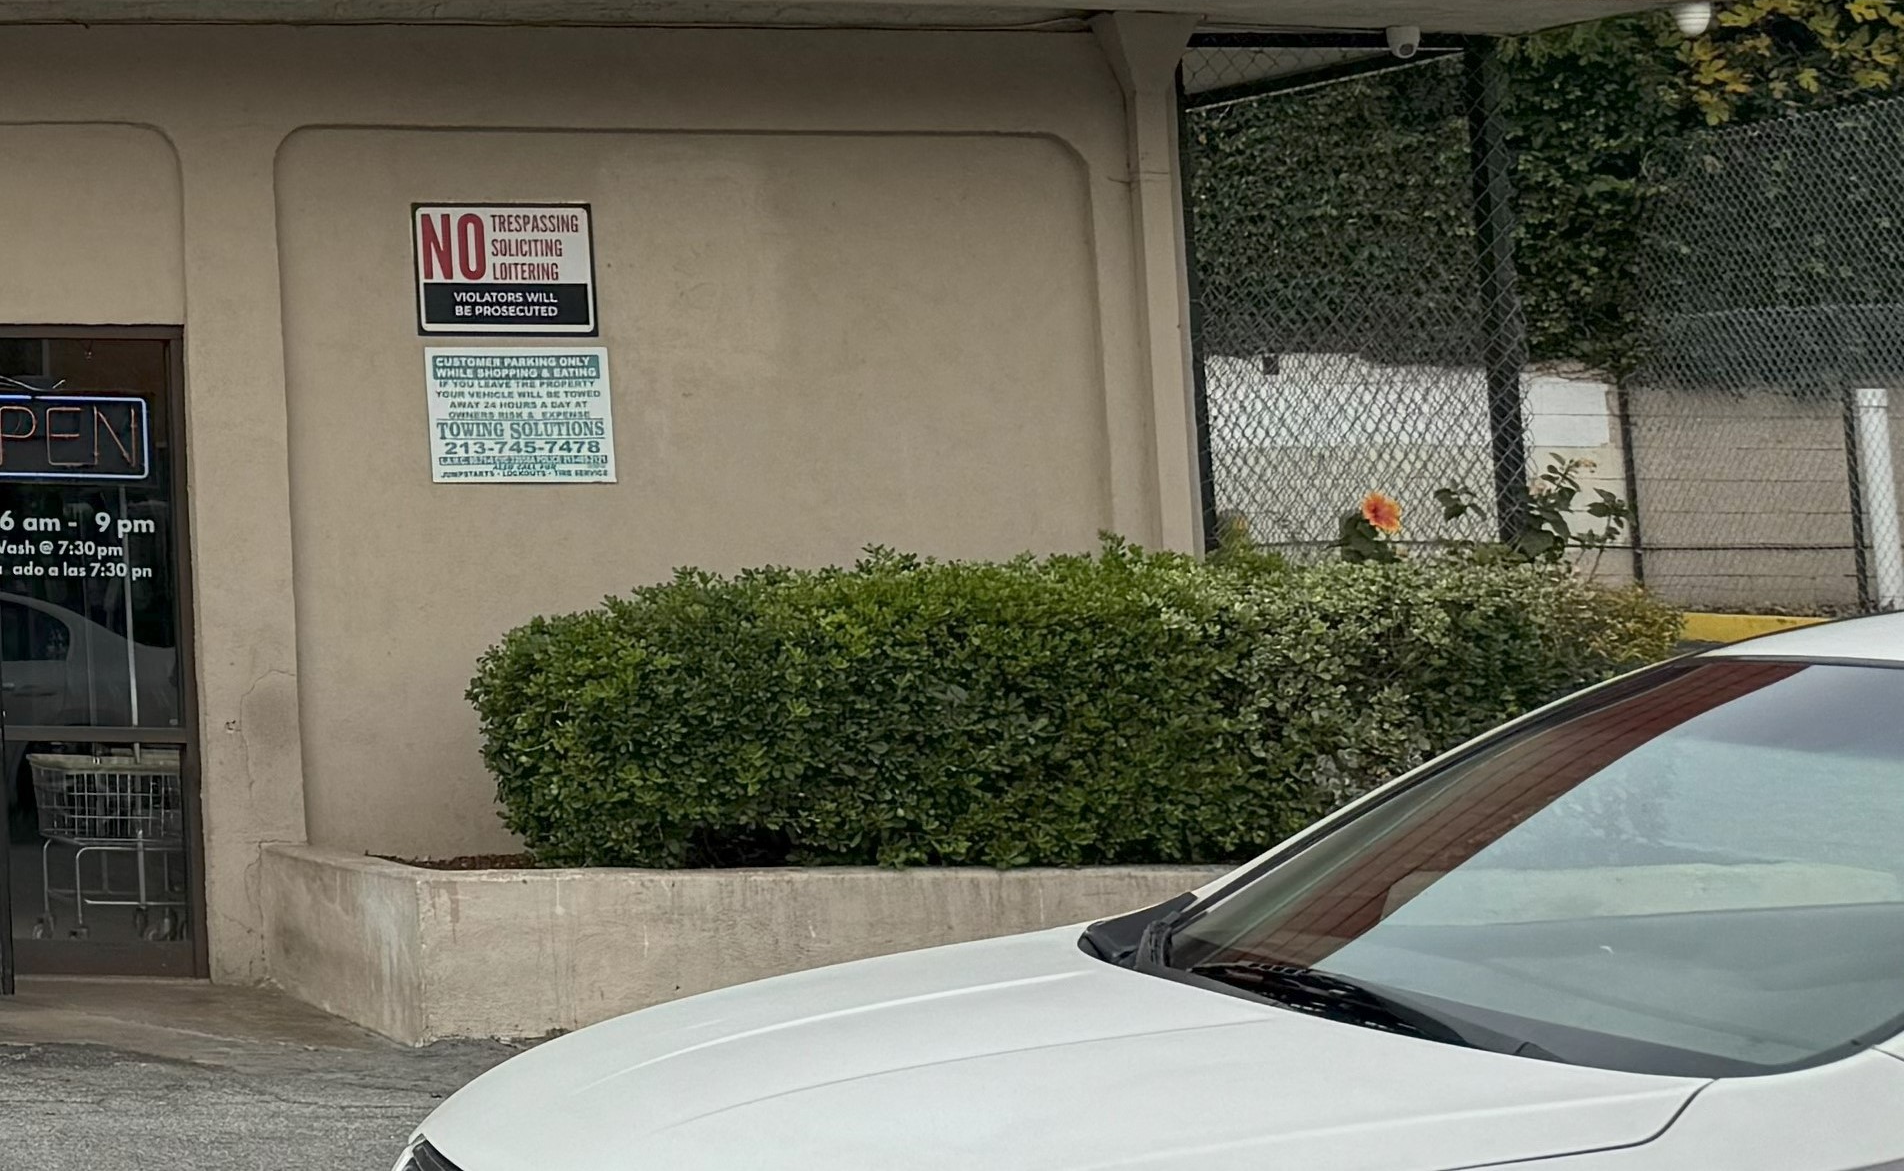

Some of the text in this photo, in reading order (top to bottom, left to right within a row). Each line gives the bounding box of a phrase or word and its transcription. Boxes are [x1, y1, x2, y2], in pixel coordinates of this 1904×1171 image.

[490, 214, 578, 232] TRESPASSING
[421, 213, 486, 280] NO
[491, 239, 562, 257] SOLICITING
[492, 262, 559, 281] LOITERING
[454, 292, 558, 303] VIOLATORS WILL
[455, 306, 558, 317] BE PROSECUTED
[436, 356, 590, 367] CUSTOMER PARKING ONLY
[436, 368, 474, 378] WHILE
[477, 368, 538, 378] SHOPPING
[553, 368, 597, 378] EATING
[439, 379, 595, 388] IF YOU LEAVE THE PROPERTY
[436, 391, 465, 399] YOUR
[468, 391, 513, 399] VEHICLE
[564, 390, 601, 398] TOWED
[449, 401, 480, 409] AWAY
[484, 401, 496, 409] 24
[500, 401, 537, 409] HOURS
[541, 401, 548, 409] A
[542, 411, 591, 419] EXPENSE
[437, 421, 605, 440] TOWING SOLUTIONS
[444, 441, 601, 455] 213-745-7478
[0, 510, 14, 531] 6
[22, 516, 60, 531] am
[95, 511, 110, 532] 9
[117, 521, 155, 538] pm
[39, 541, 53, 555] @
[48, 565, 59, 576] a
[63, 562, 86, 577] las
[90, 562, 127, 577] 7:30
